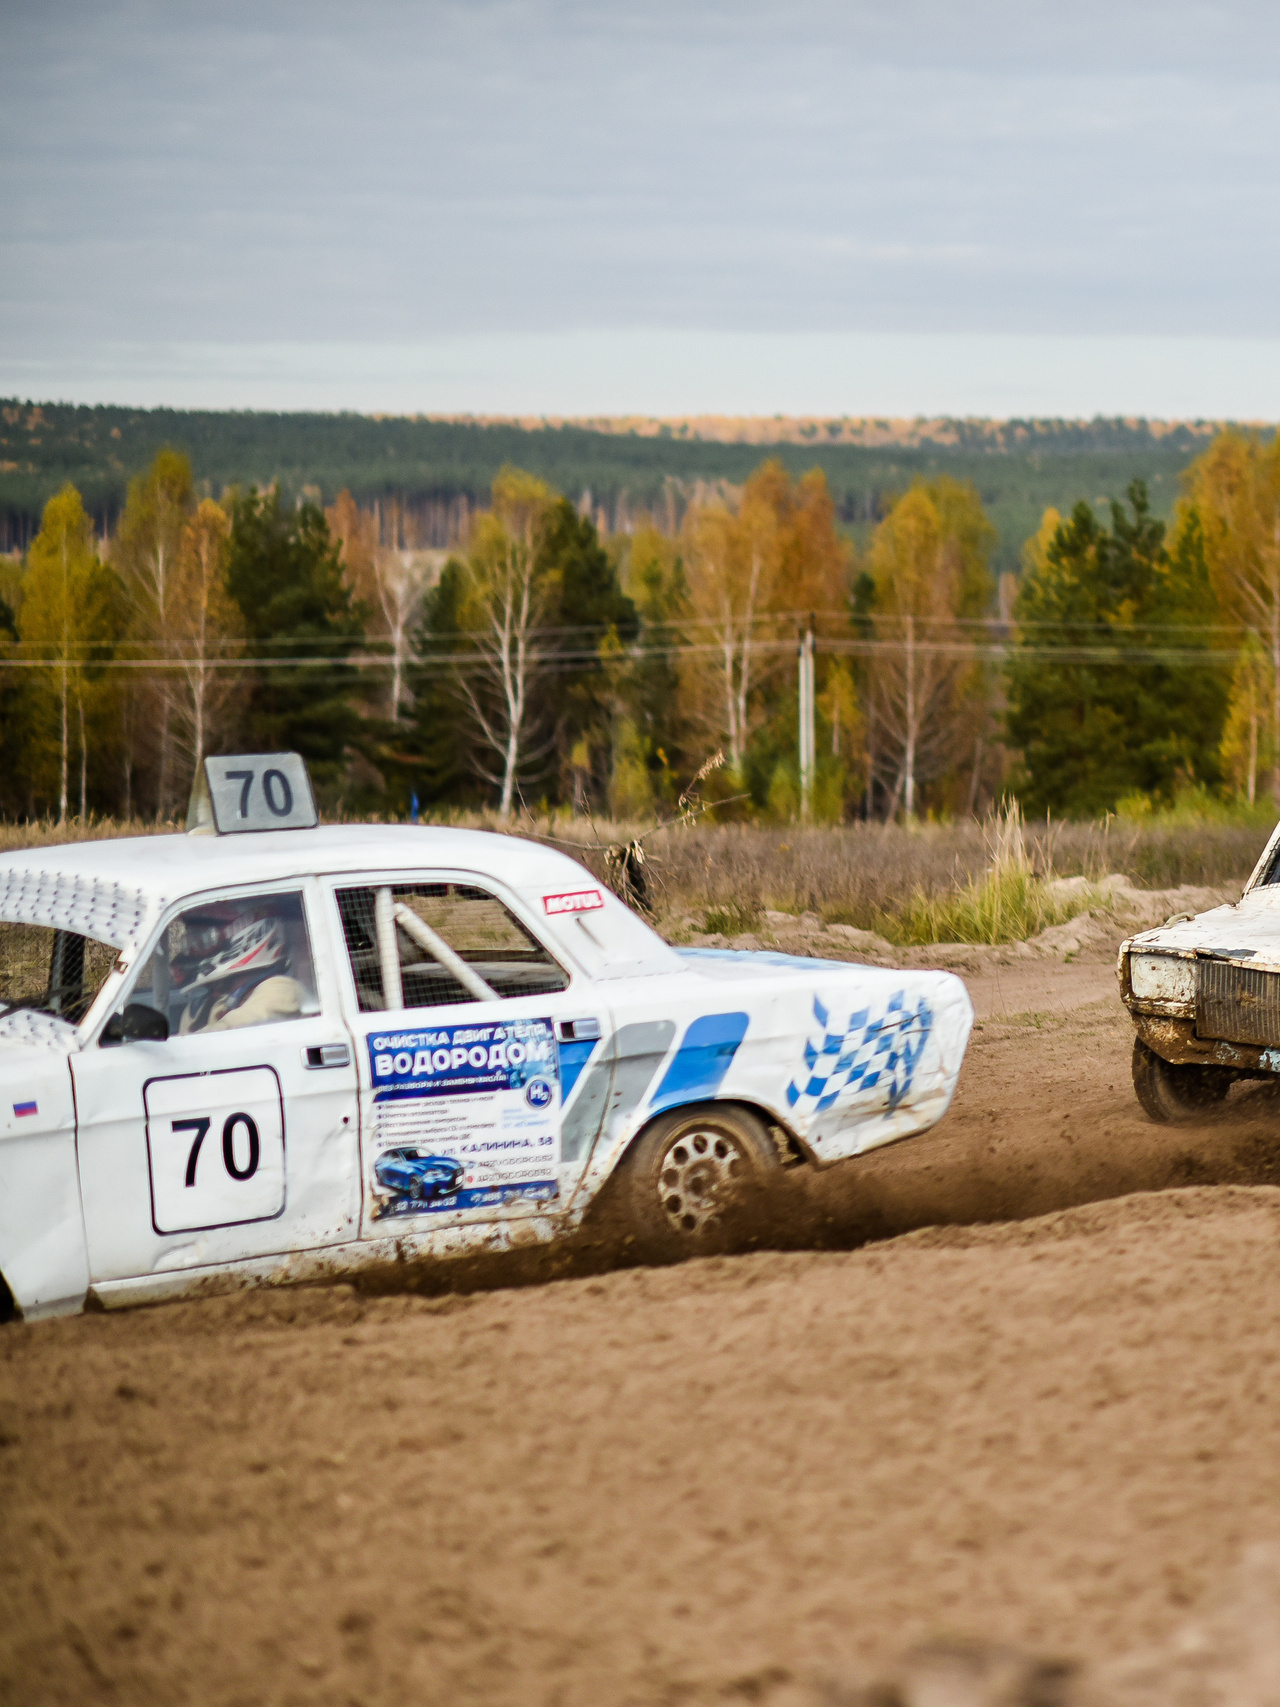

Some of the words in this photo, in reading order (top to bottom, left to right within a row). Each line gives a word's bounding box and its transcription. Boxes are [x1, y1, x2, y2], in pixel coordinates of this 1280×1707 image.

[225, 769, 293, 818] 70
[546, 892, 602, 912] MOTUL
[373, 1032, 450, 1051] ОЧИСТКА
[452, 1023, 547, 1045] ДВИГАТЕЛЯ
[375, 1039, 552, 1076] ВОДОРОДОМ
[171, 1112, 260, 1187] 70
